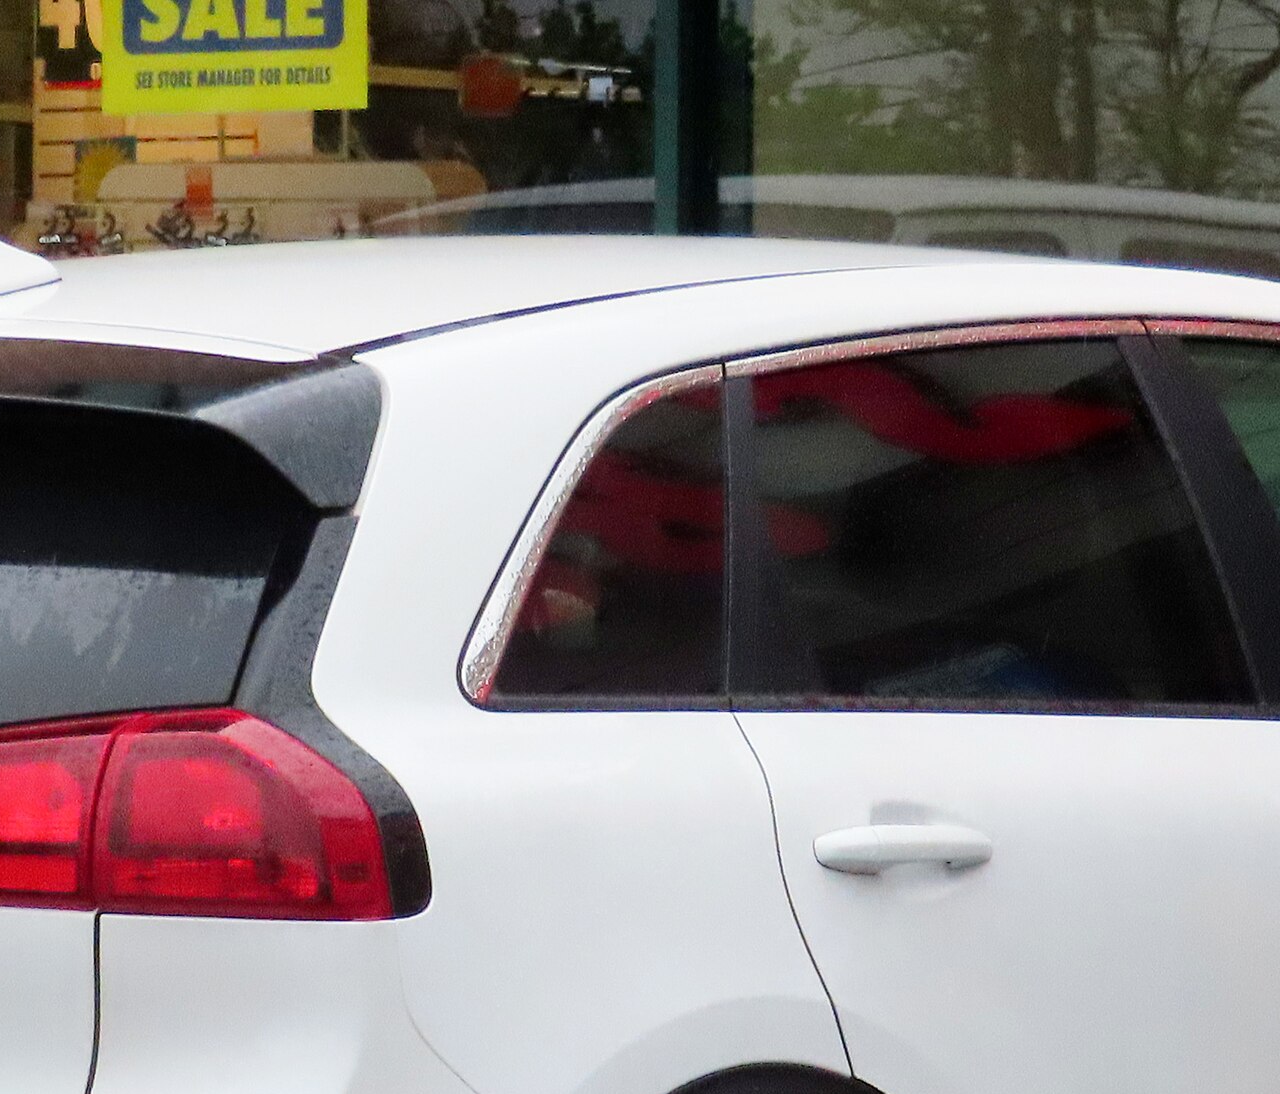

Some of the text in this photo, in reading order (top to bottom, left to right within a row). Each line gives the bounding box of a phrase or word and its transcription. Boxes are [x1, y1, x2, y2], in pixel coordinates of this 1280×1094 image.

[140, 0, 325, 42] SALE
[136, 66, 331, 89] SEE STORE MANAGER FOR DETAILS
